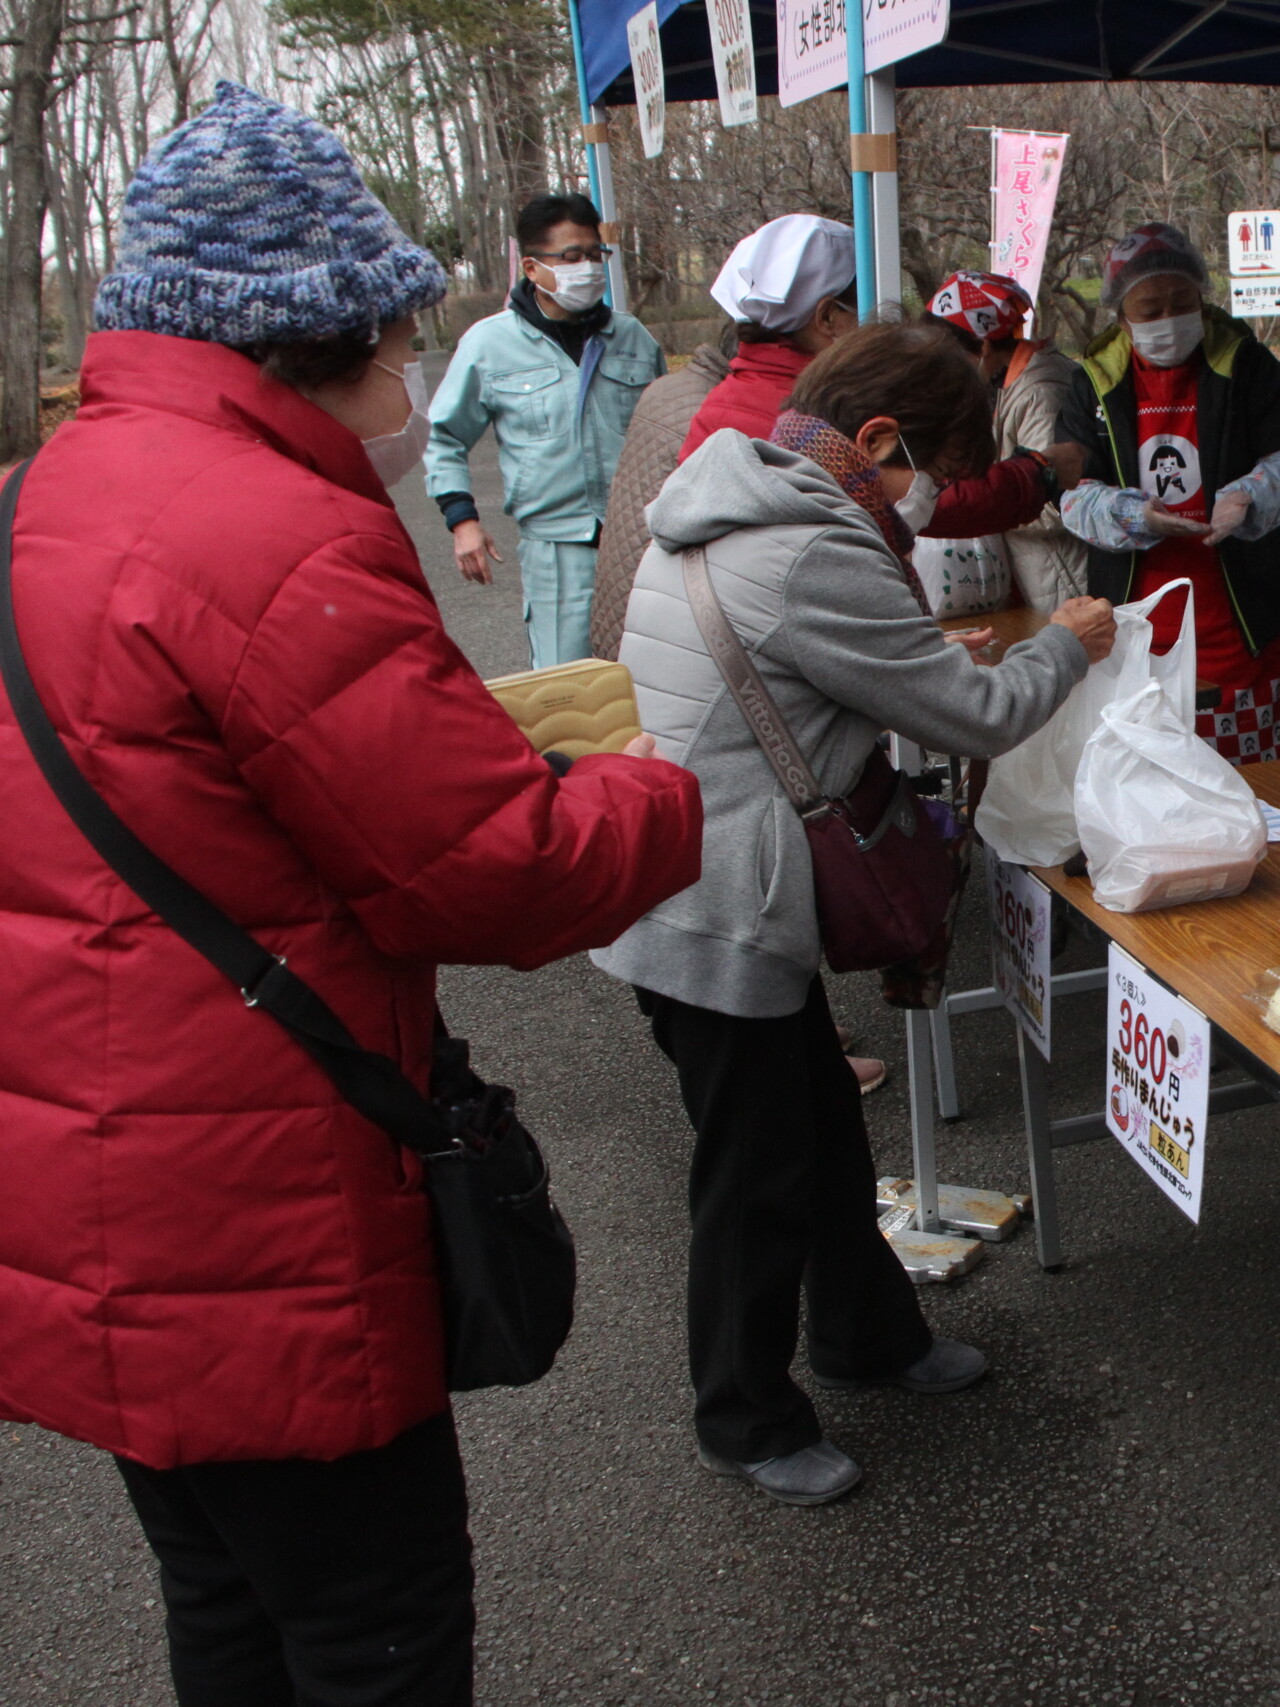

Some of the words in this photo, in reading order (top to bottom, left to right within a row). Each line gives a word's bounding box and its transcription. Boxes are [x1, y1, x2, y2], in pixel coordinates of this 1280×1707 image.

[1111, 1047, 1195, 1148] 手作りまんじゅう
[1158, 1131, 1185, 1172] 粒あん
